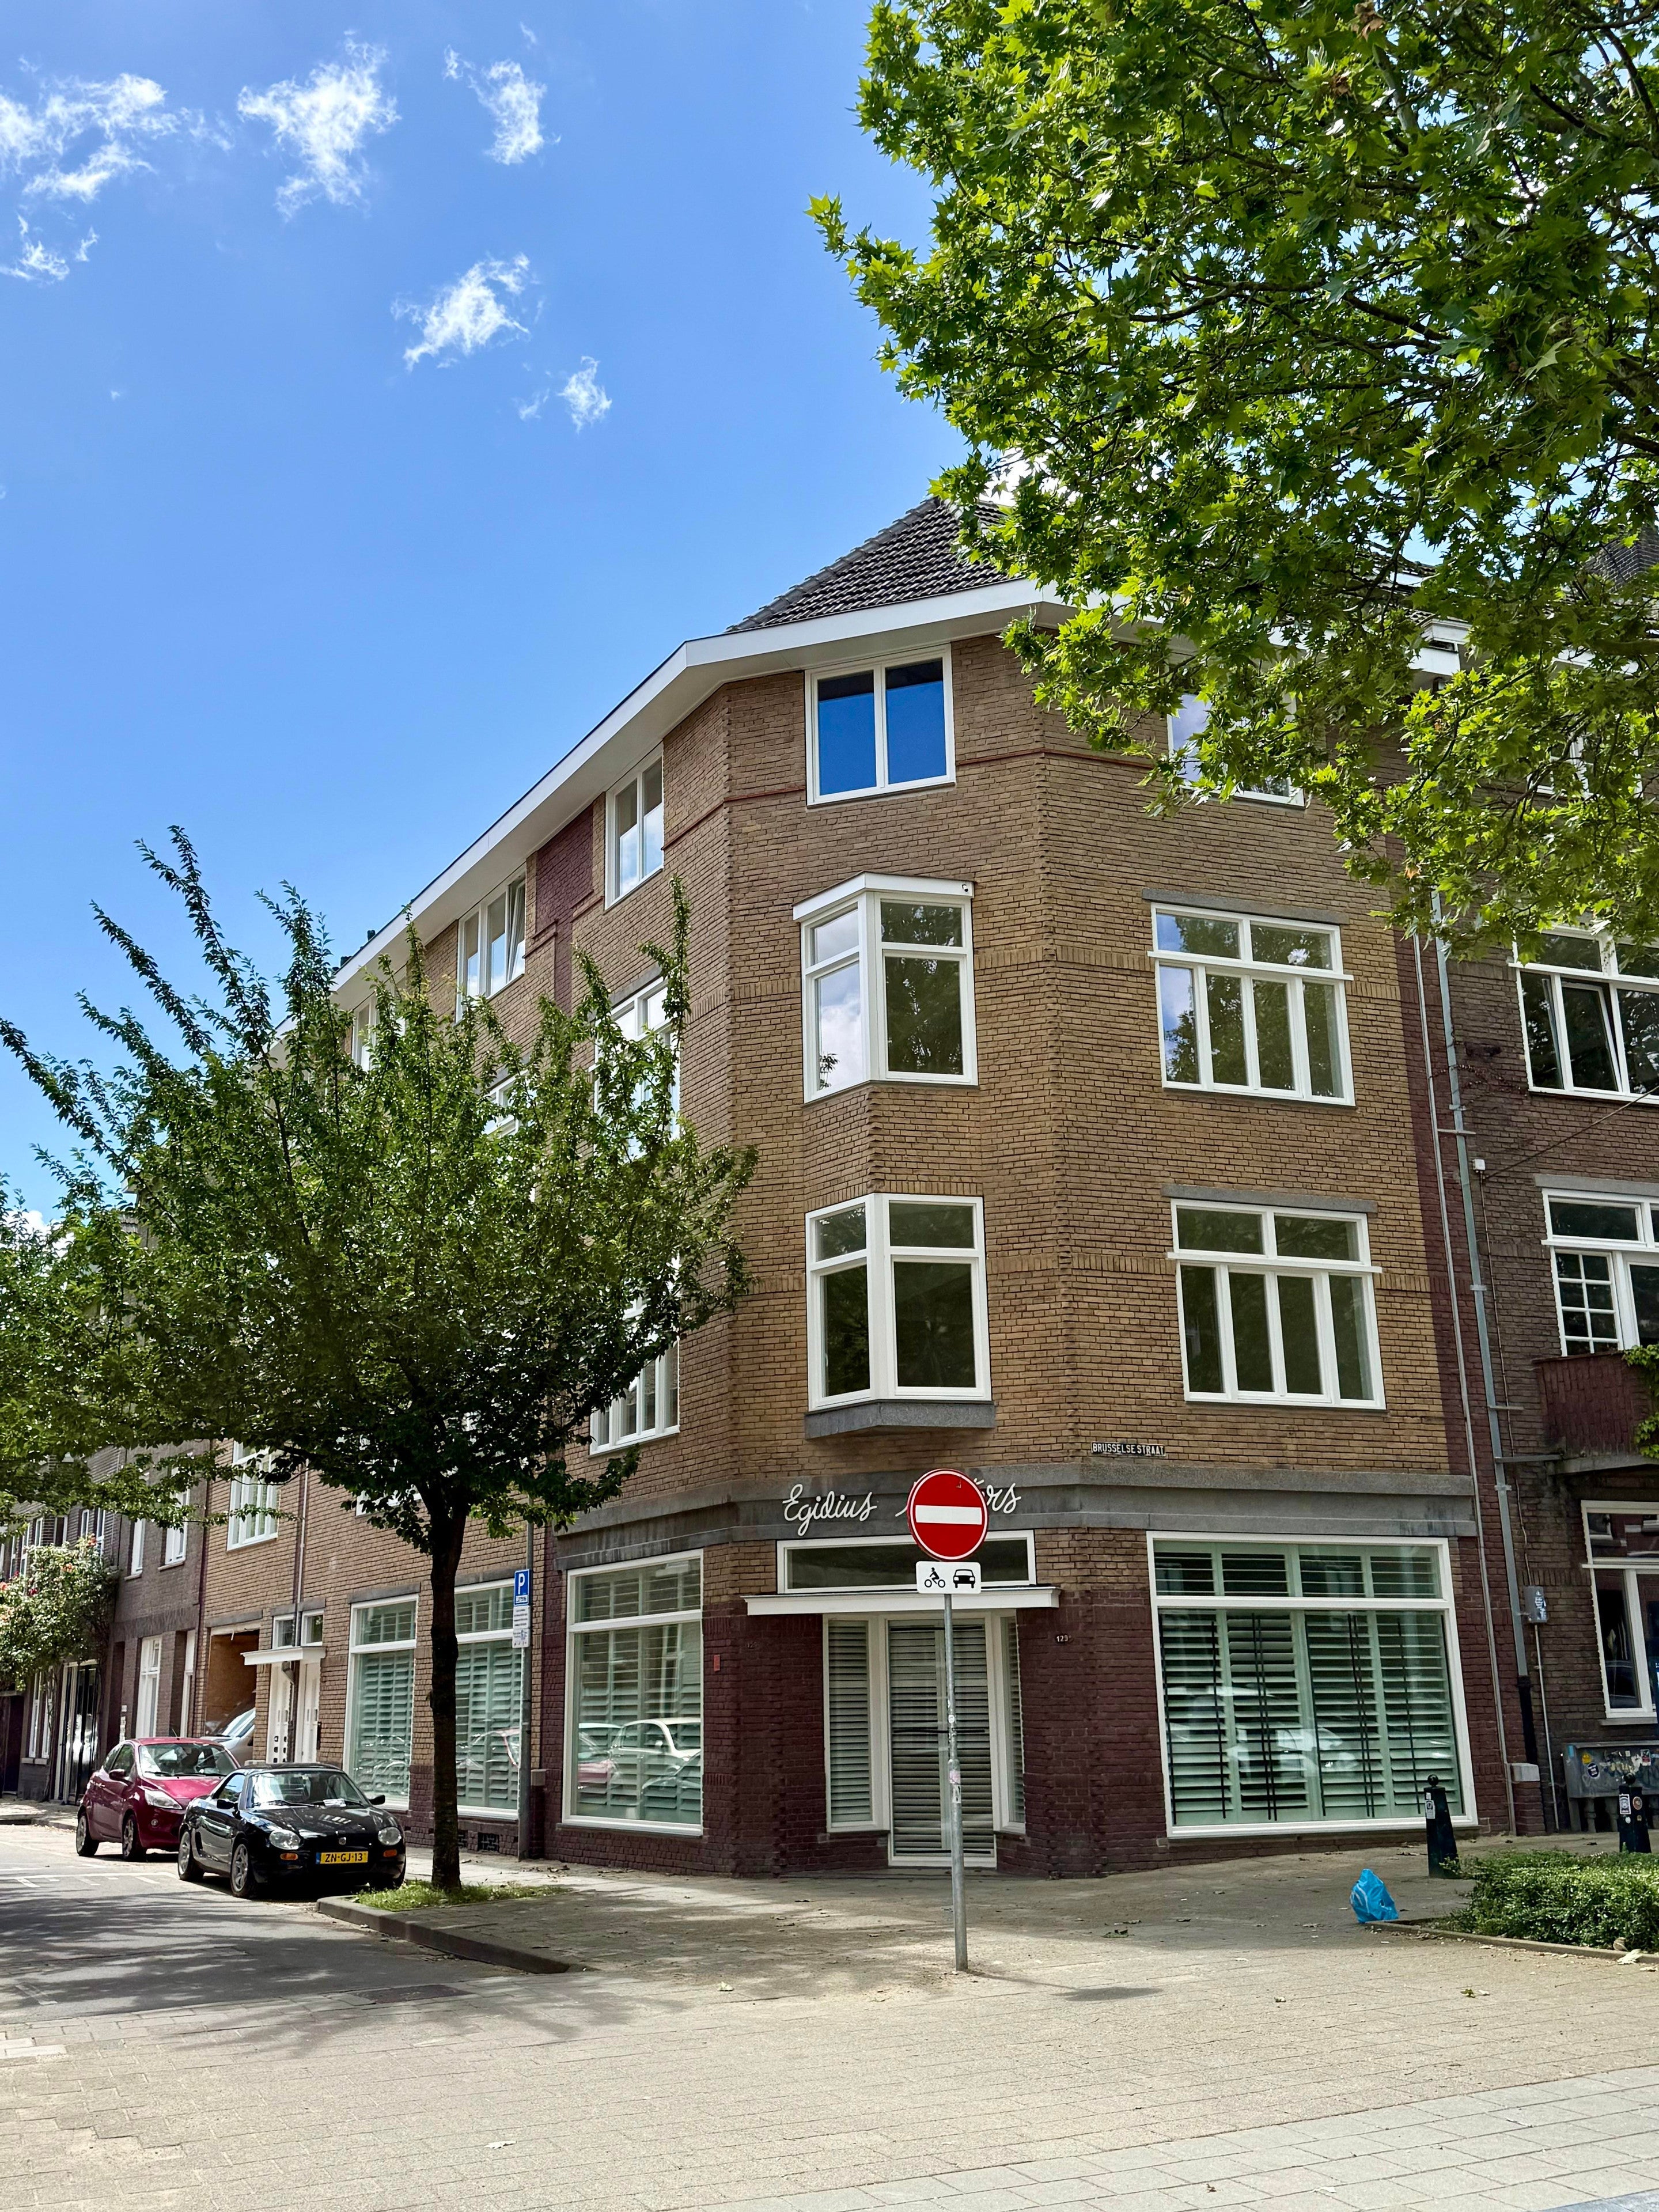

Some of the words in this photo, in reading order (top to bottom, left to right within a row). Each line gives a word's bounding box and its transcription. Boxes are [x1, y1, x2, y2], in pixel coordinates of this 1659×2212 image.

[782, 1483, 877, 1536] Egidius
[518, 1573, 525, 1594] P
[325, 1853, 363, 1862] ZN-GJ-13
